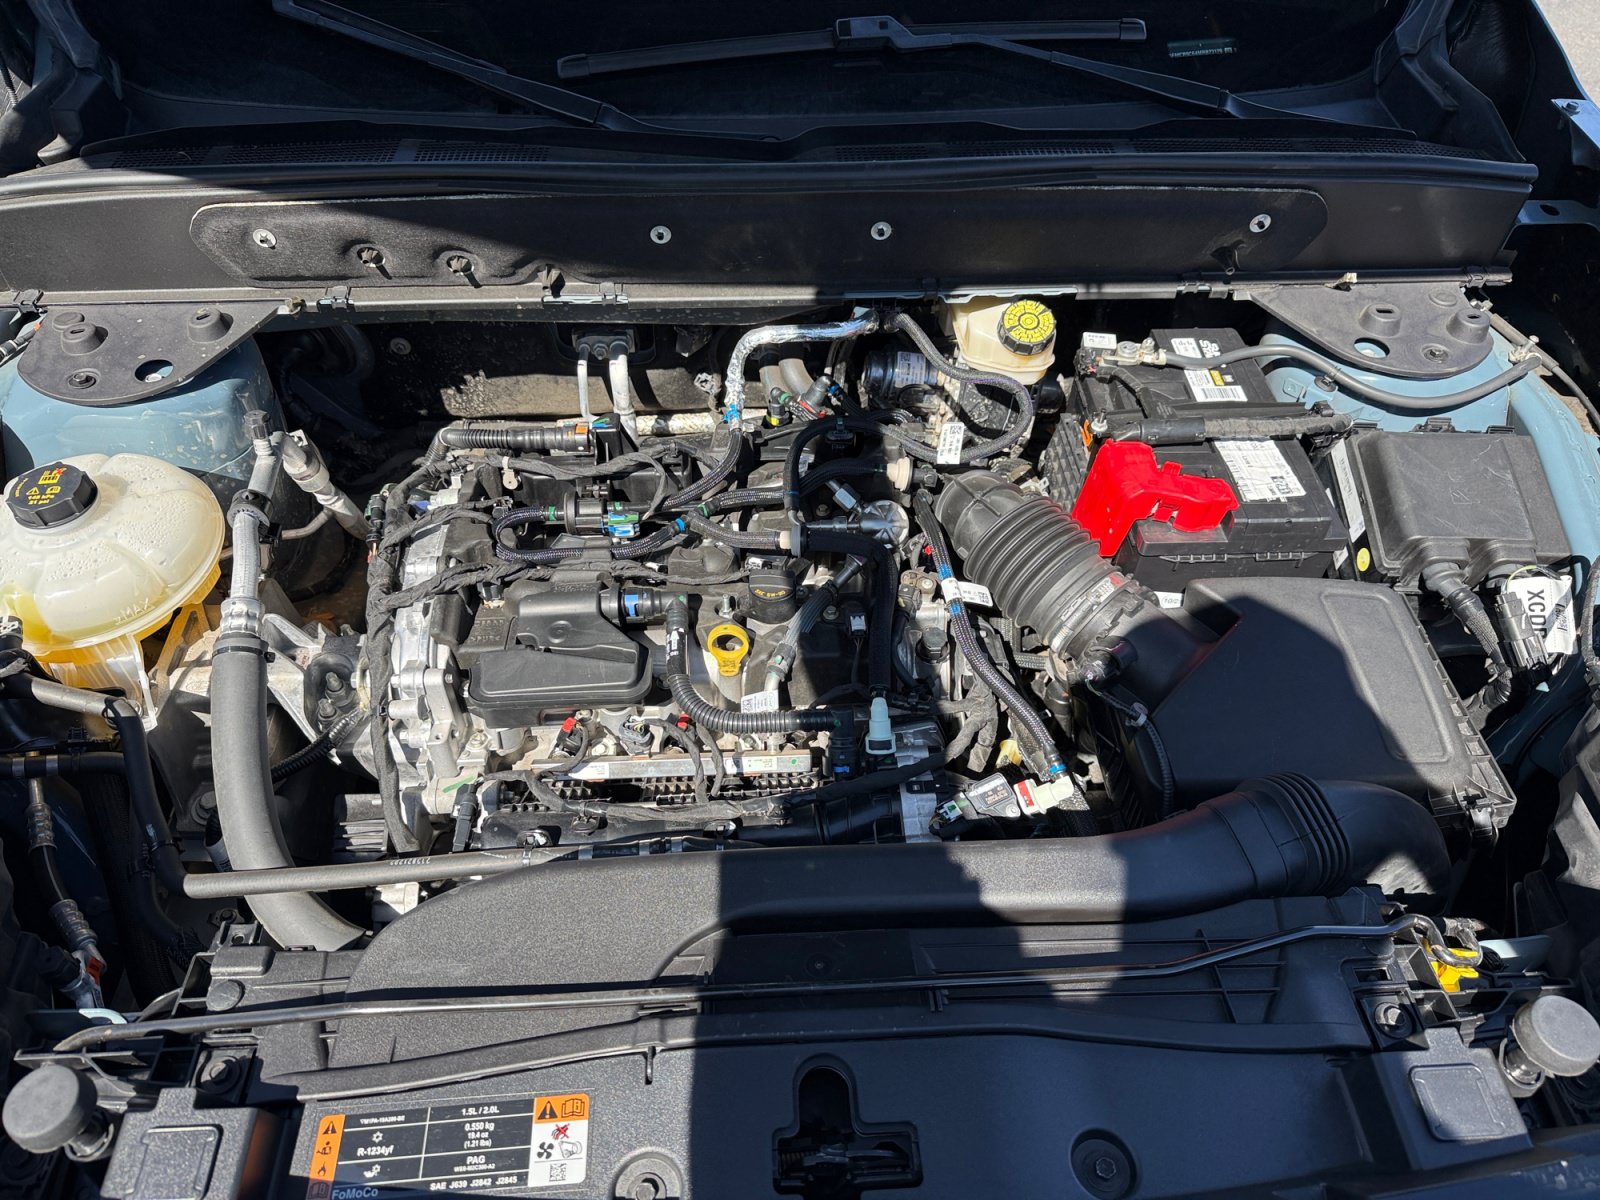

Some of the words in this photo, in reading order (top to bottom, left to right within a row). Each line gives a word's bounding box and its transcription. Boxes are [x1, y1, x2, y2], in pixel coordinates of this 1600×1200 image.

[461, 1108, 478, 1116] 1.5L
[483, 1106, 500, 1114] 2.0L
[464, 1122, 484, 1132] 0.550
[485, 1121, 495, 1131] kg
[357, 1145, 394, 1156] R-1234yf
[466, 1155, 486, 1165] PAG
[429, 1181, 447, 1191] SAE
[331, 1186, 379, 1200] FoMoCo
